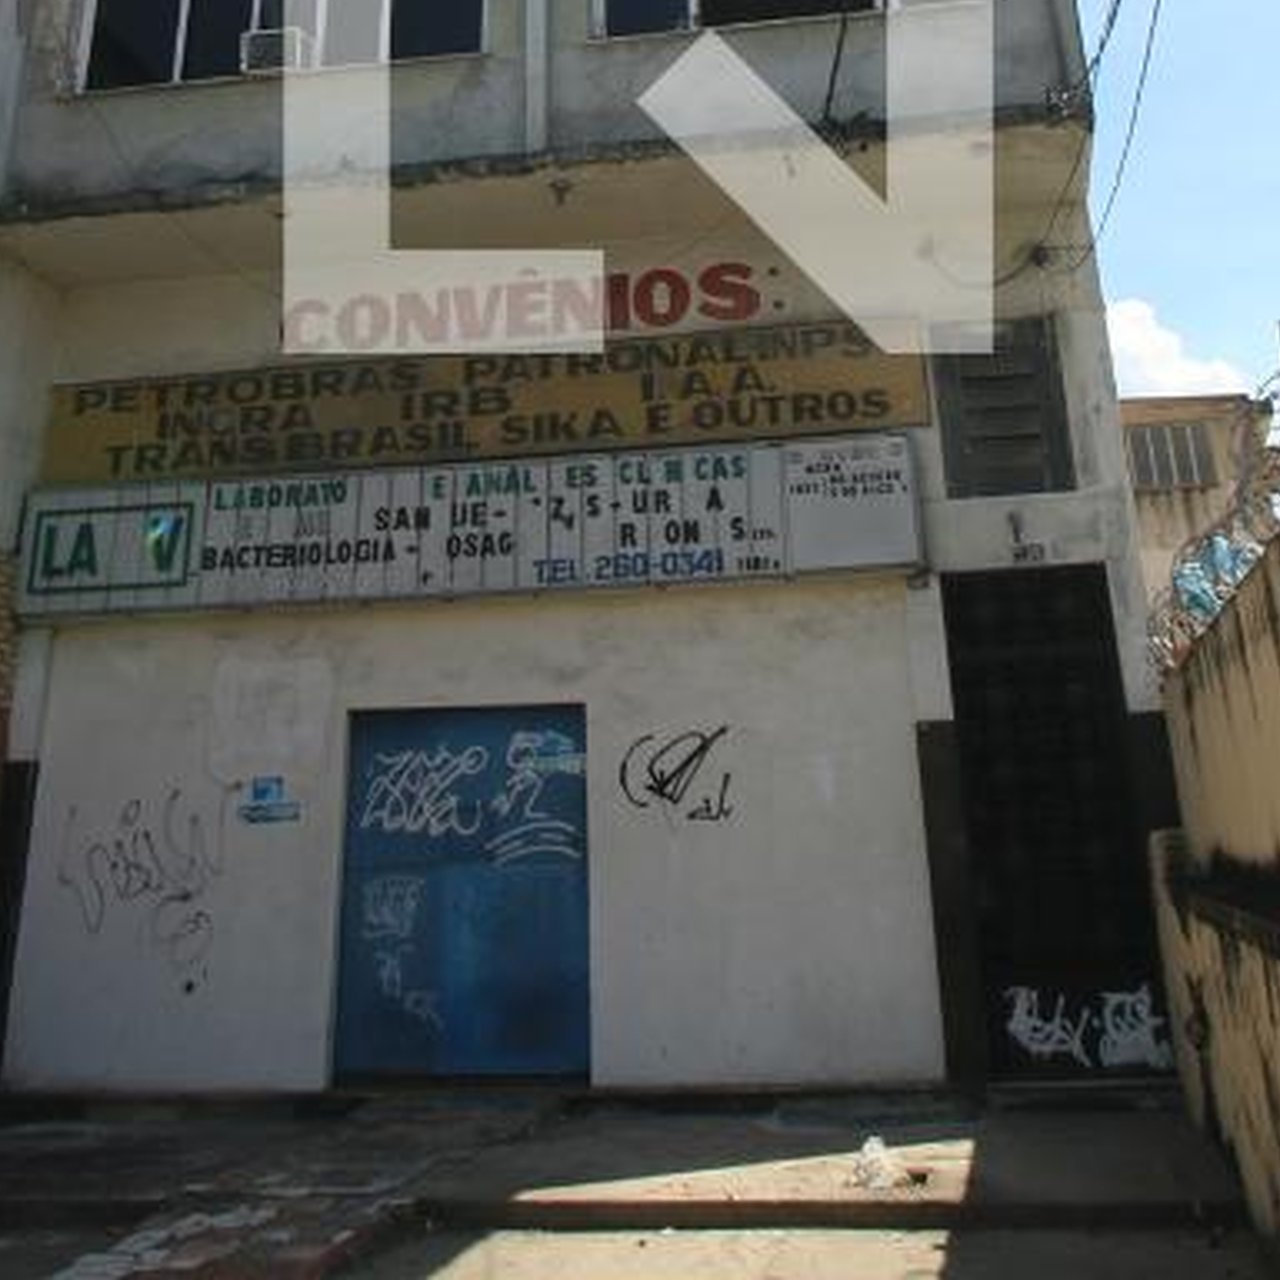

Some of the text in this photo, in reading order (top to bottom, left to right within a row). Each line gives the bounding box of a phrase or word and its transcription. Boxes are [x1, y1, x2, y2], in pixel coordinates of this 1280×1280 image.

[72, 358, 420, 416] PETROBRAS
[462, 332, 750, 385] PATRONAL
[157, 402, 314, 440] INCRA
[400, 386, 511, 422] IRB
[500, 408, 628, 446] SIKA
[646, 402, 669, 434] E
[692, 389, 890, 431] OUTROS
[199, 536, 397, 572] BACTERIOLOGIA
[595, 548, 725, 582] 260-0341
